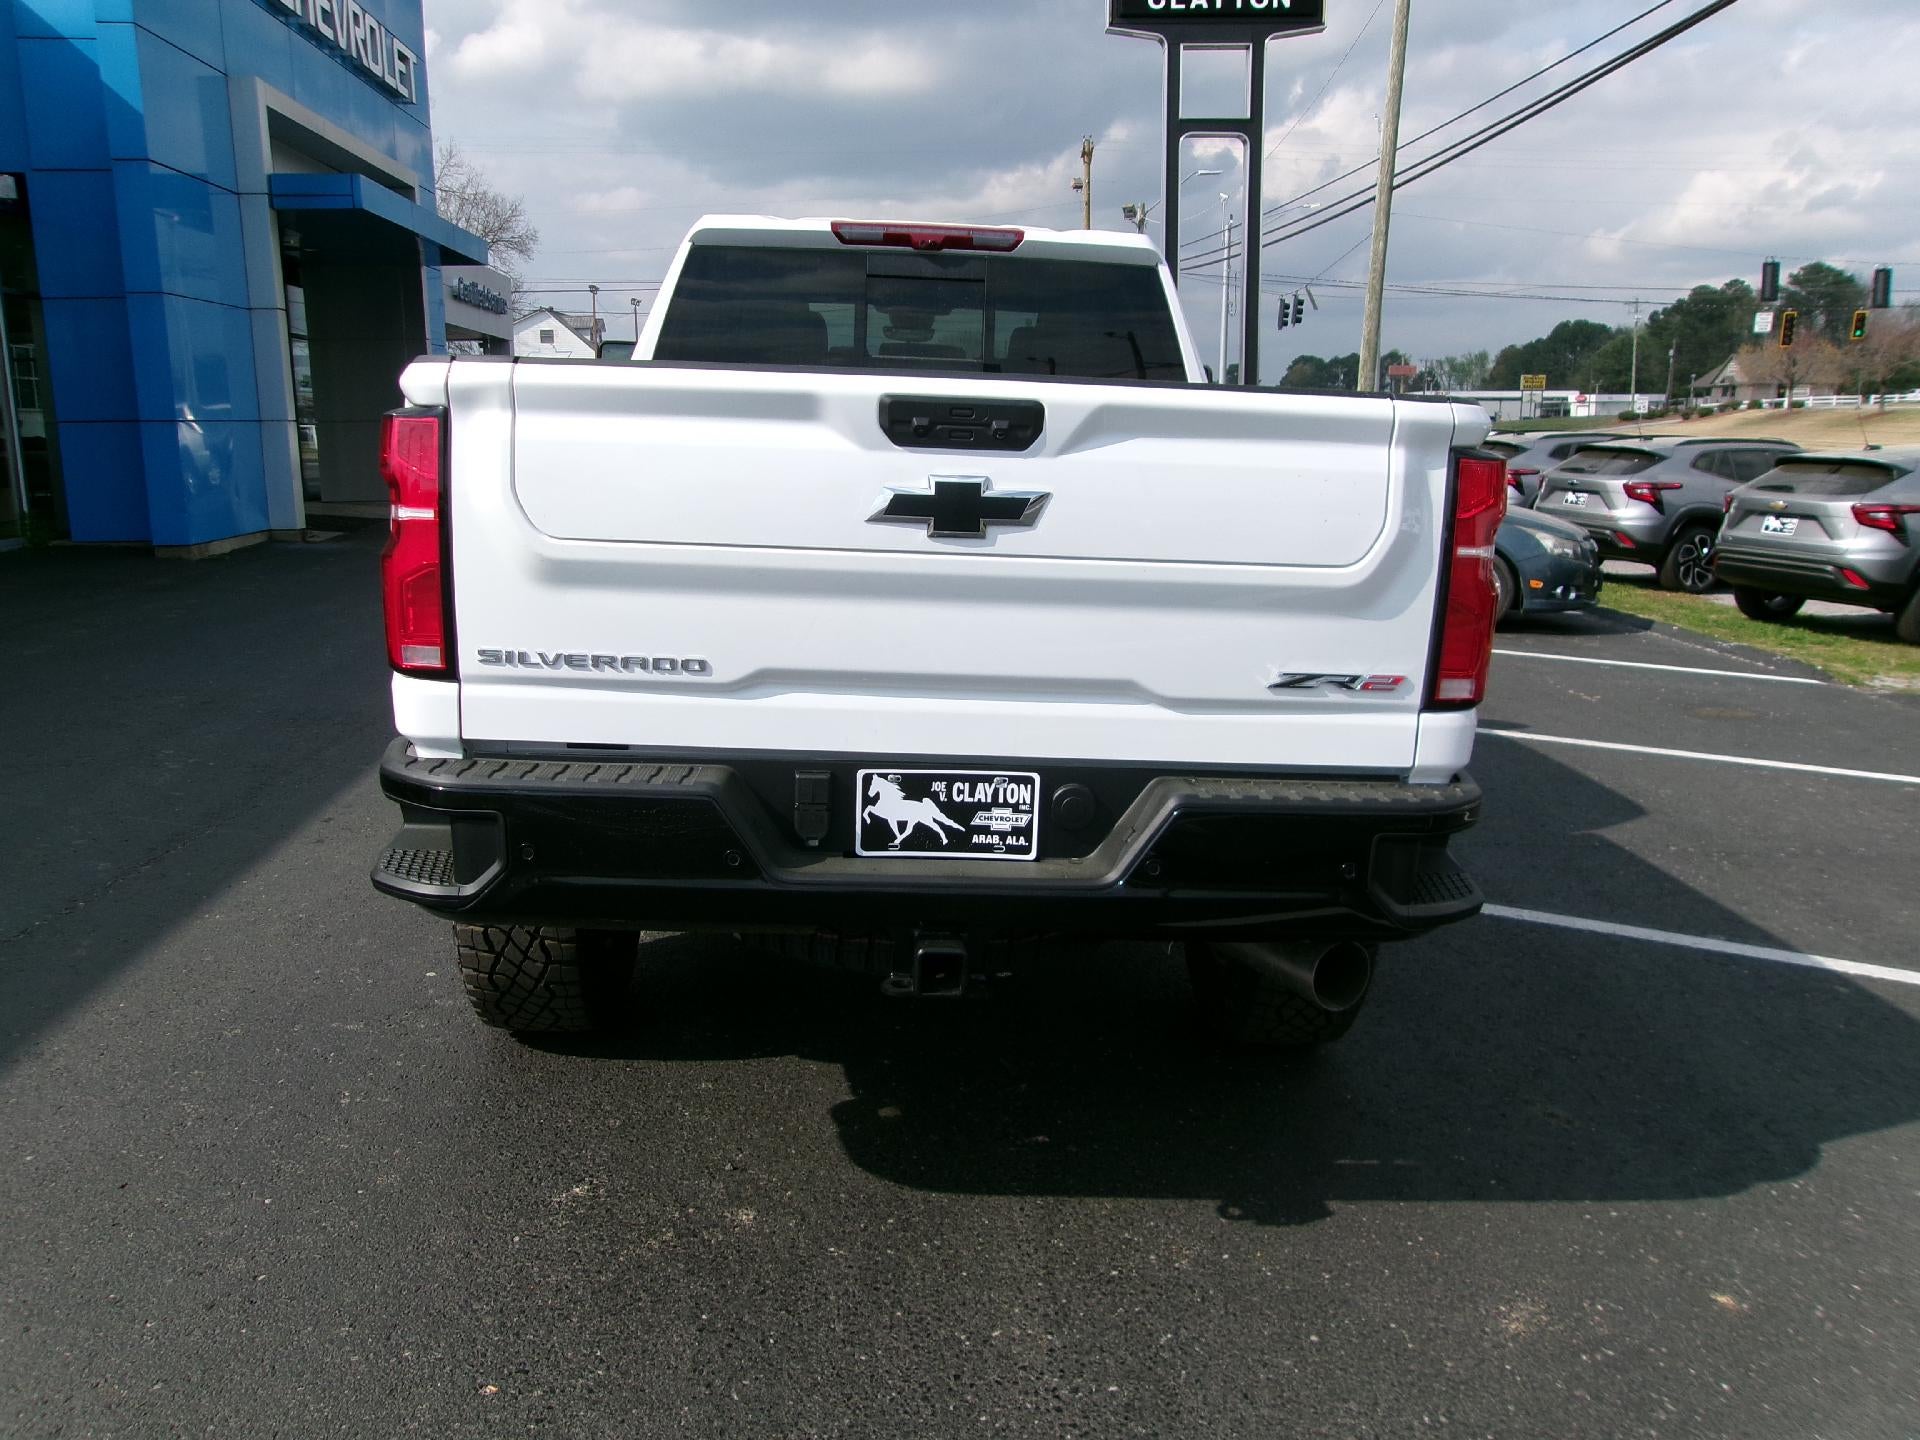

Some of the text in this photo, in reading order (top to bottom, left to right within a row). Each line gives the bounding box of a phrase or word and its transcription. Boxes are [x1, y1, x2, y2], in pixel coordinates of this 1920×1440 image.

[279, 0, 417, 104] EVROLET
[477, 649, 709, 673] SILVERADO
[1266, 672, 1409, 692] ZR2
[931, 781, 947, 792] JOE
[952, 781, 1032, 804] CLAYTON
[939, 792, 948, 802] V.
[978, 814, 1025, 824] CHEVROLET
[972, 834, 1029, 846] ARAB, ALA.
